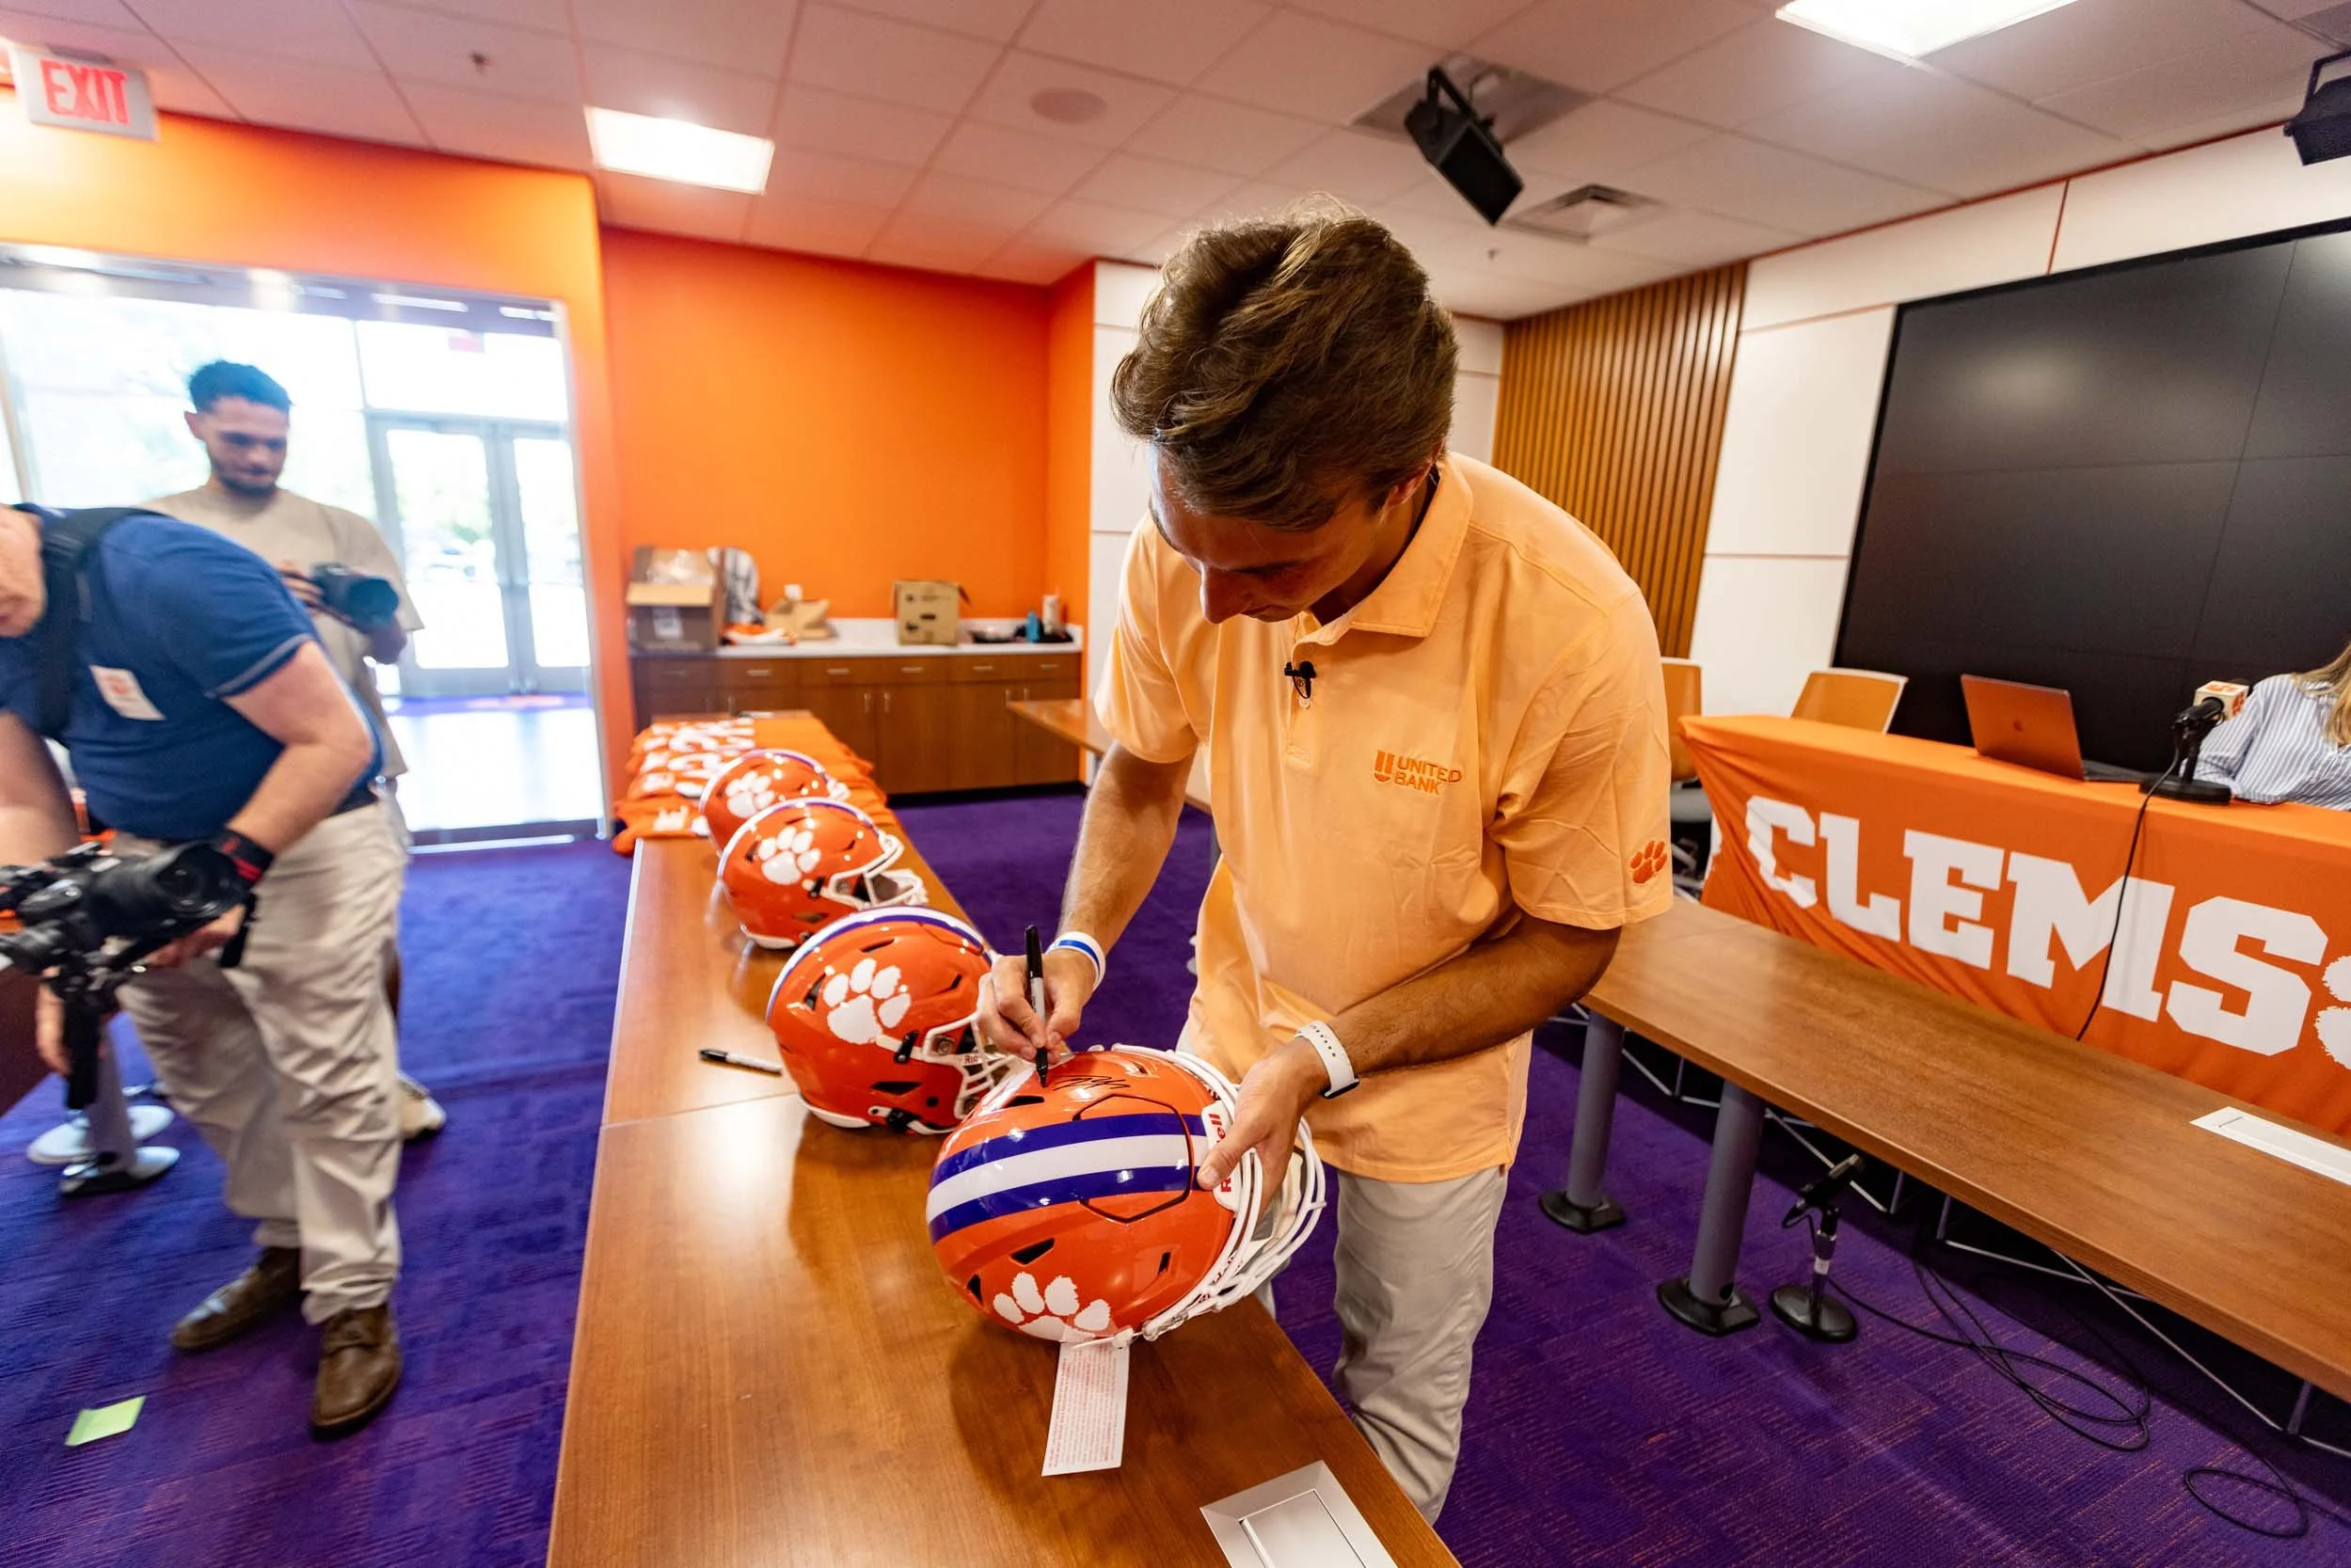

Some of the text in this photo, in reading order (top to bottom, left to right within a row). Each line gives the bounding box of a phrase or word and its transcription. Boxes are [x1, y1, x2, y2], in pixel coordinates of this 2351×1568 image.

[40, 58, 130, 125] EXIT
[1393, 771, 1439, 796] BANK
[1397, 756, 1462, 783] UNITED
[1746, 795, 2351, 1069] CLEMS
[1208, 1113, 1231, 1193] Rell
